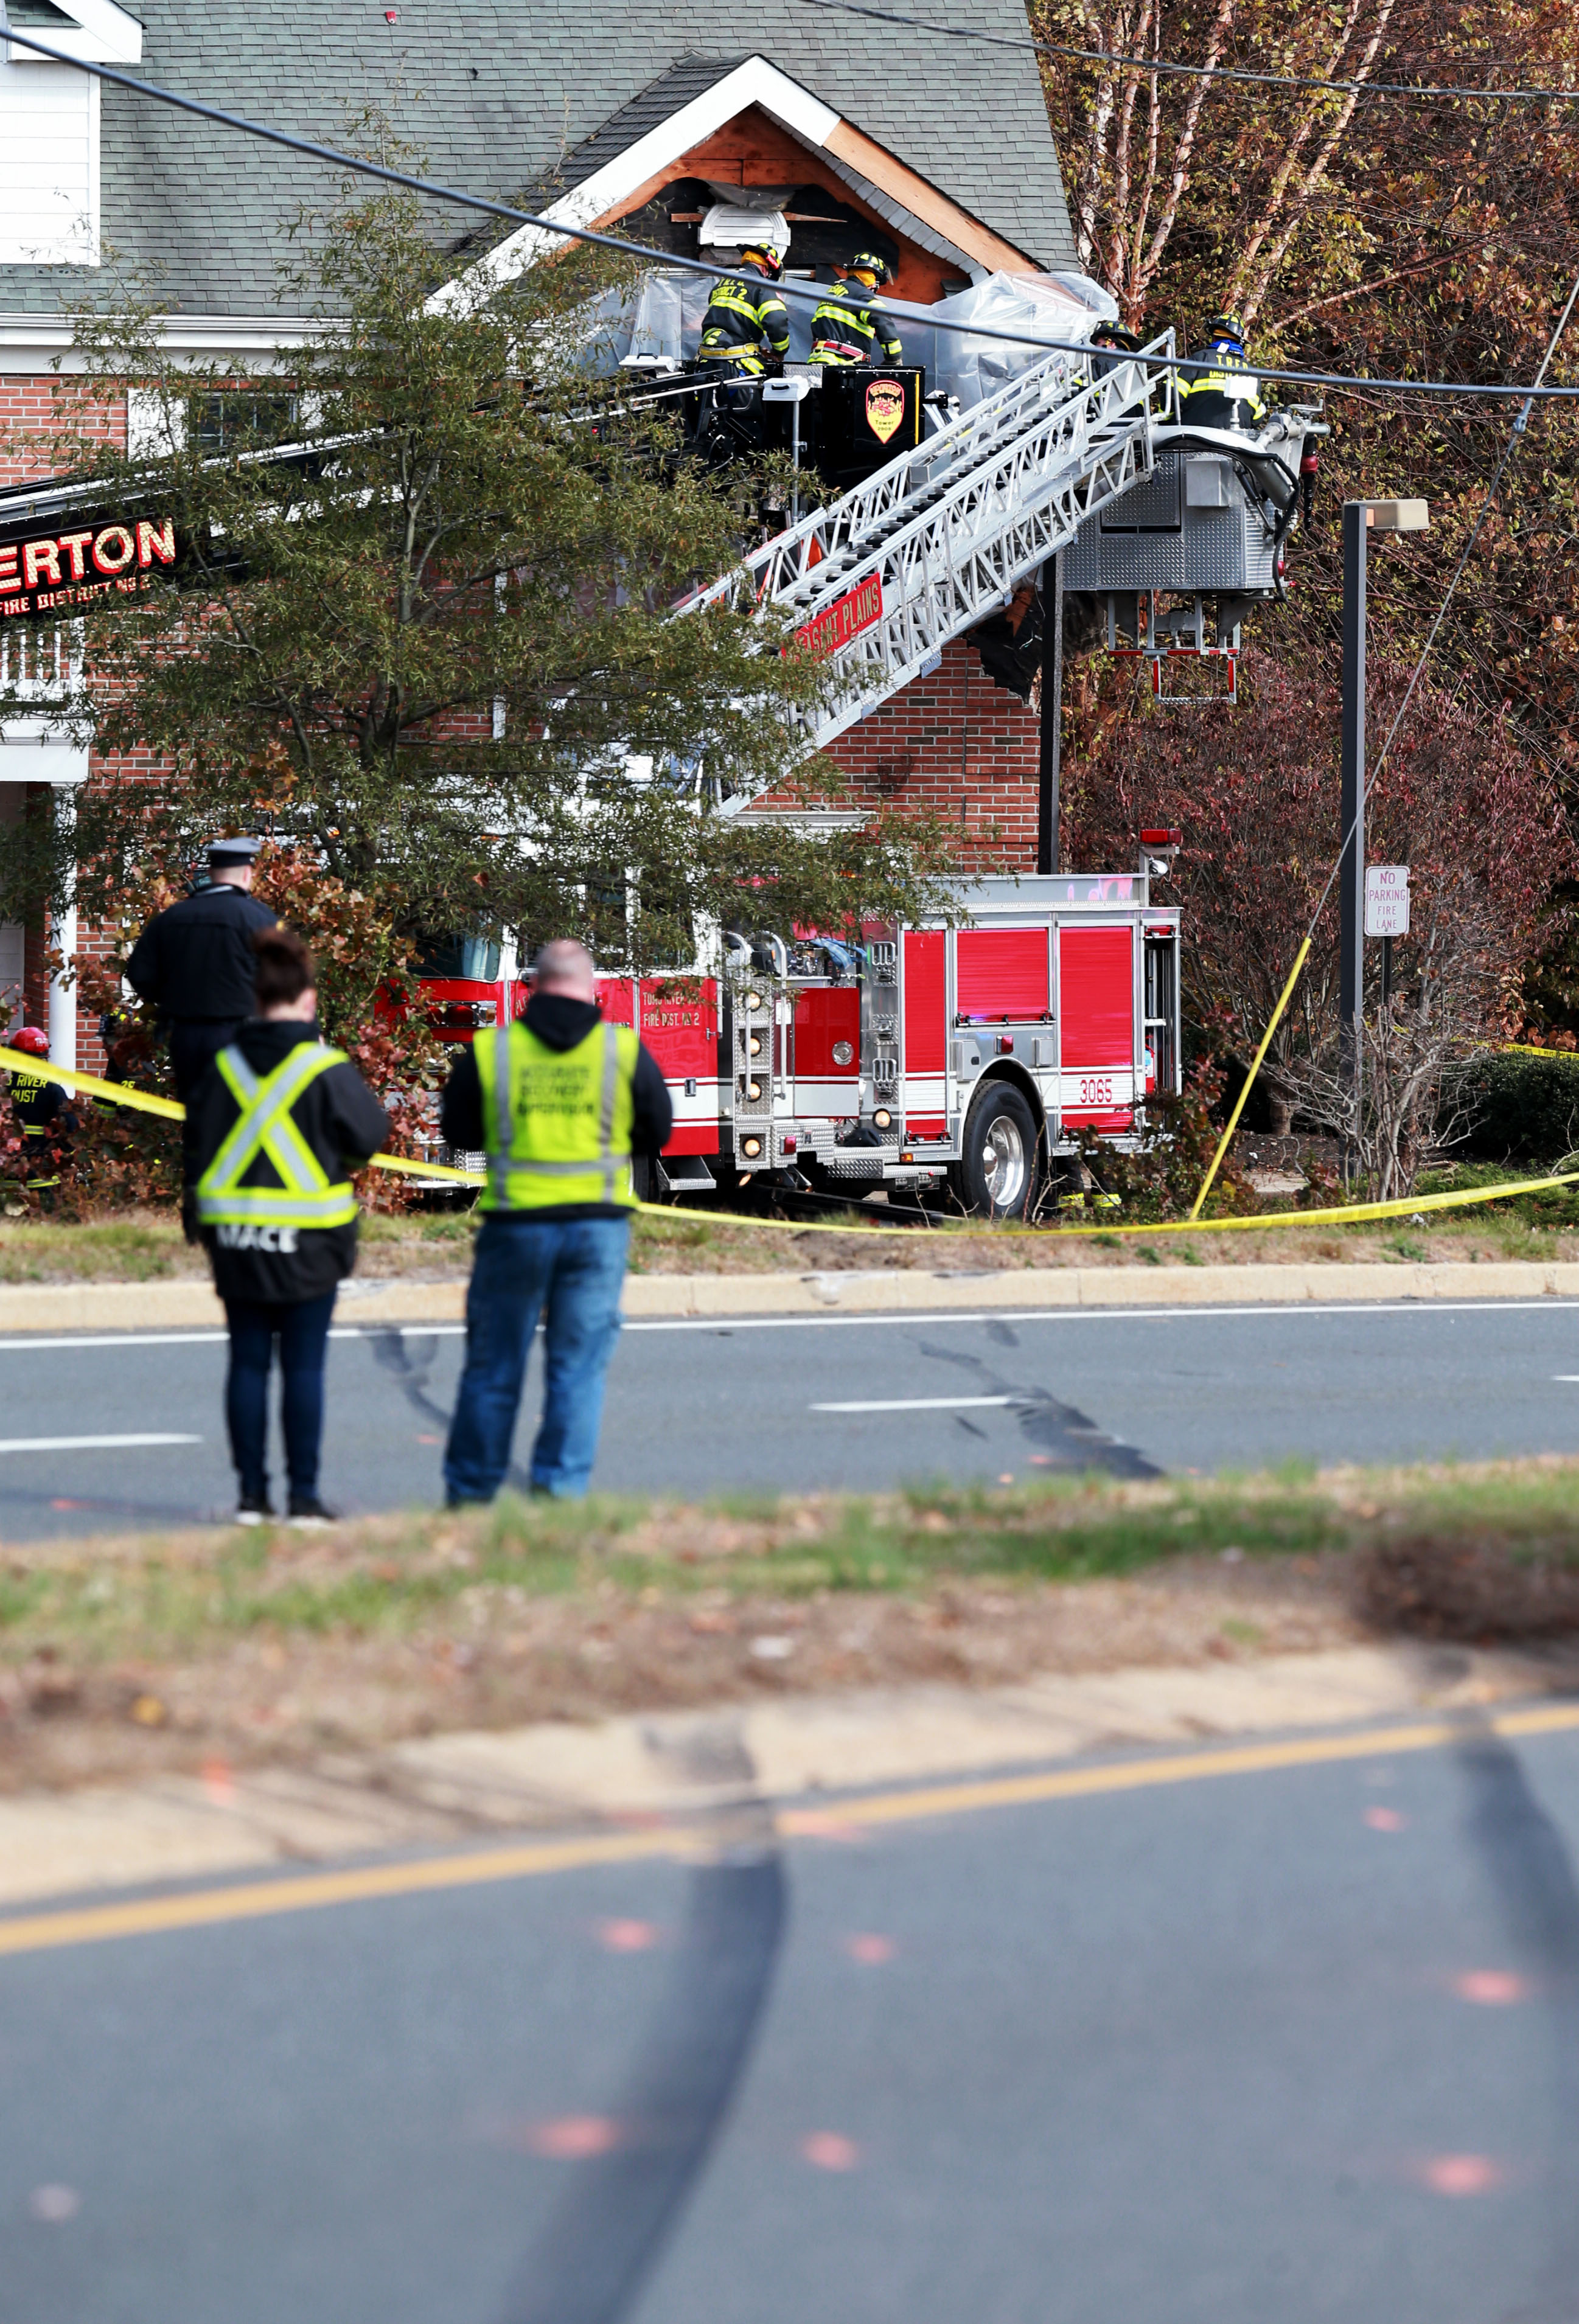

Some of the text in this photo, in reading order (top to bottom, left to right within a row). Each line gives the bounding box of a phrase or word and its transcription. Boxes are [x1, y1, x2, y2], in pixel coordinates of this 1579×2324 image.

[737, 287, 748, 300] 2
[842, 582, 880, 636] PLAINS
[1380, 872, 1396, 884] NO
[1369, 889, 1406, 901] PARKING
[1377, 906, 1396, 915] FIRE
[1376, 920, 1397, 929] LANE
[643, 1013, 660, 1026] FIRE
[694, 1012, 700, 1026] 2
[16, 1074, 48, 1088] RIVER
[1080, 1078, 1112, 1104] 3065
